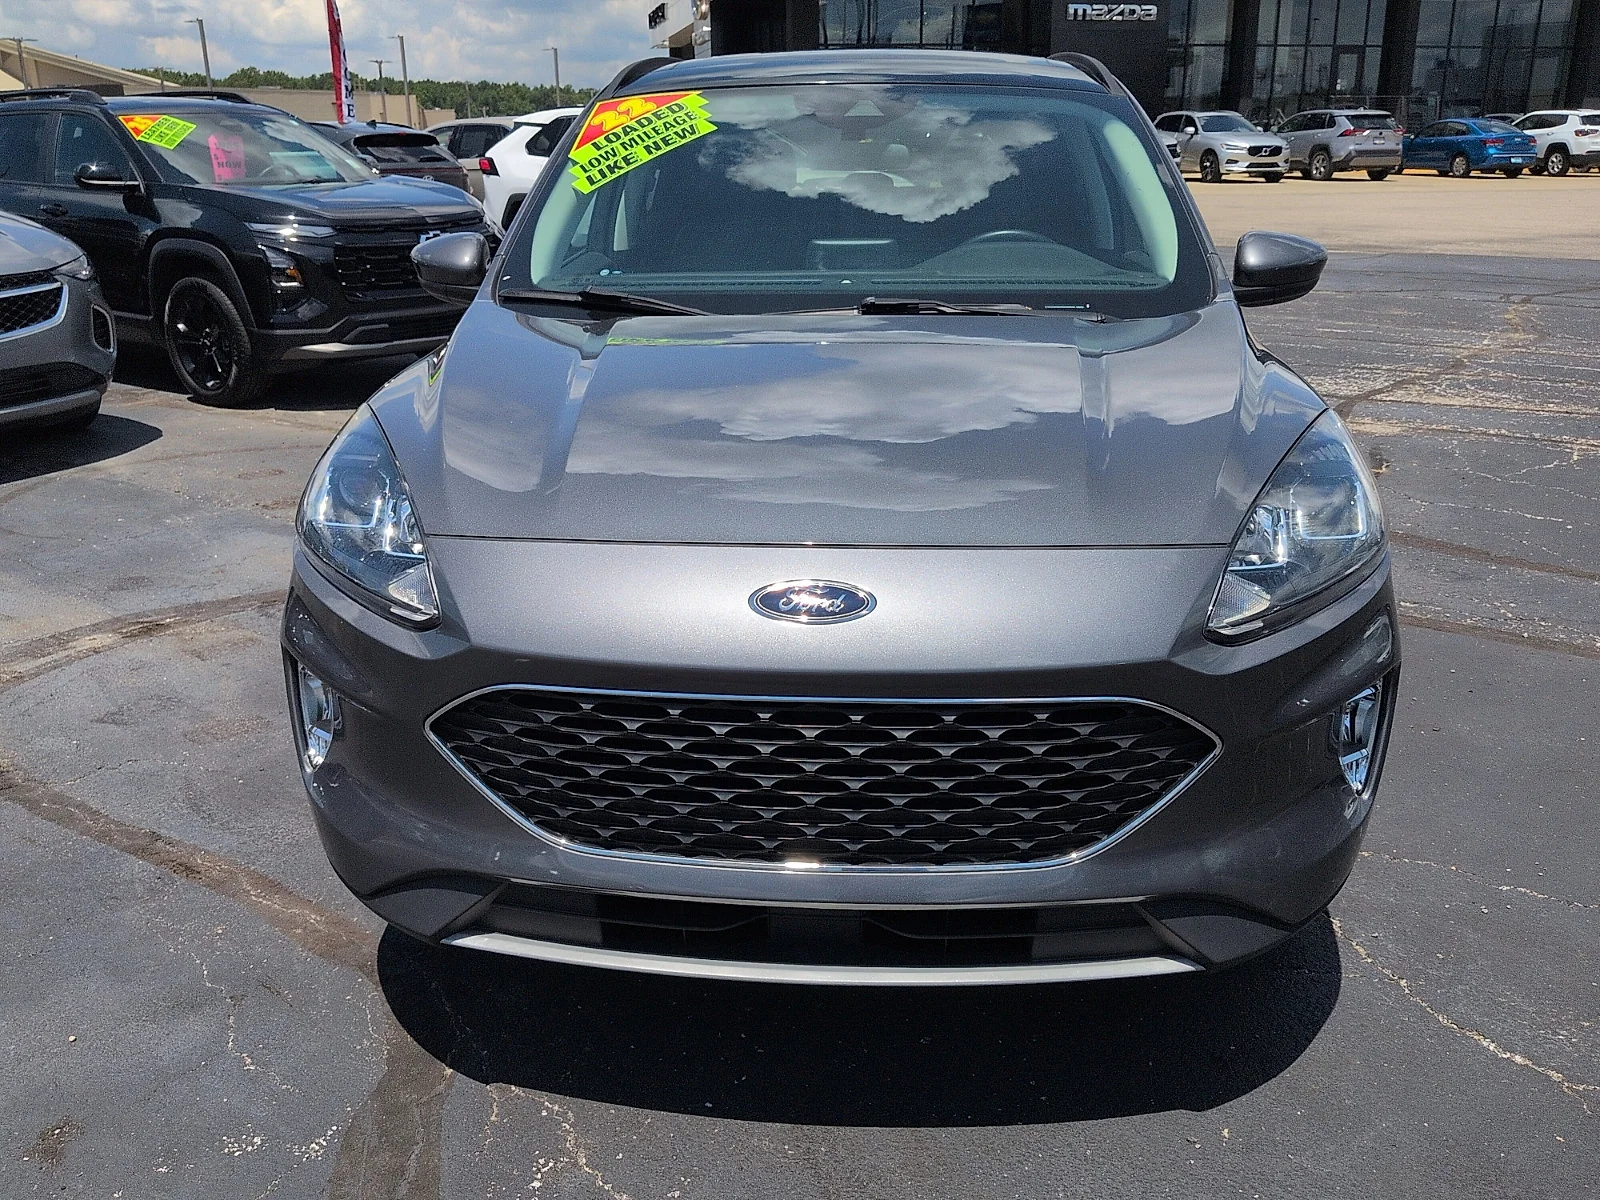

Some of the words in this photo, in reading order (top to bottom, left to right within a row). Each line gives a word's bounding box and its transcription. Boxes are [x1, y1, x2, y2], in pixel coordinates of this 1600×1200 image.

[590, 97, 657, 132] 22
[591, 102, 687, 151] LOADED
[579, 146, 618, 174] LOW
[619, 111, 698, 151] MILEAGE
[585, 151, 639, 187] LIKE
[643, 123, 698, 156] NEW
[779, 588, 847, 613] Ford
